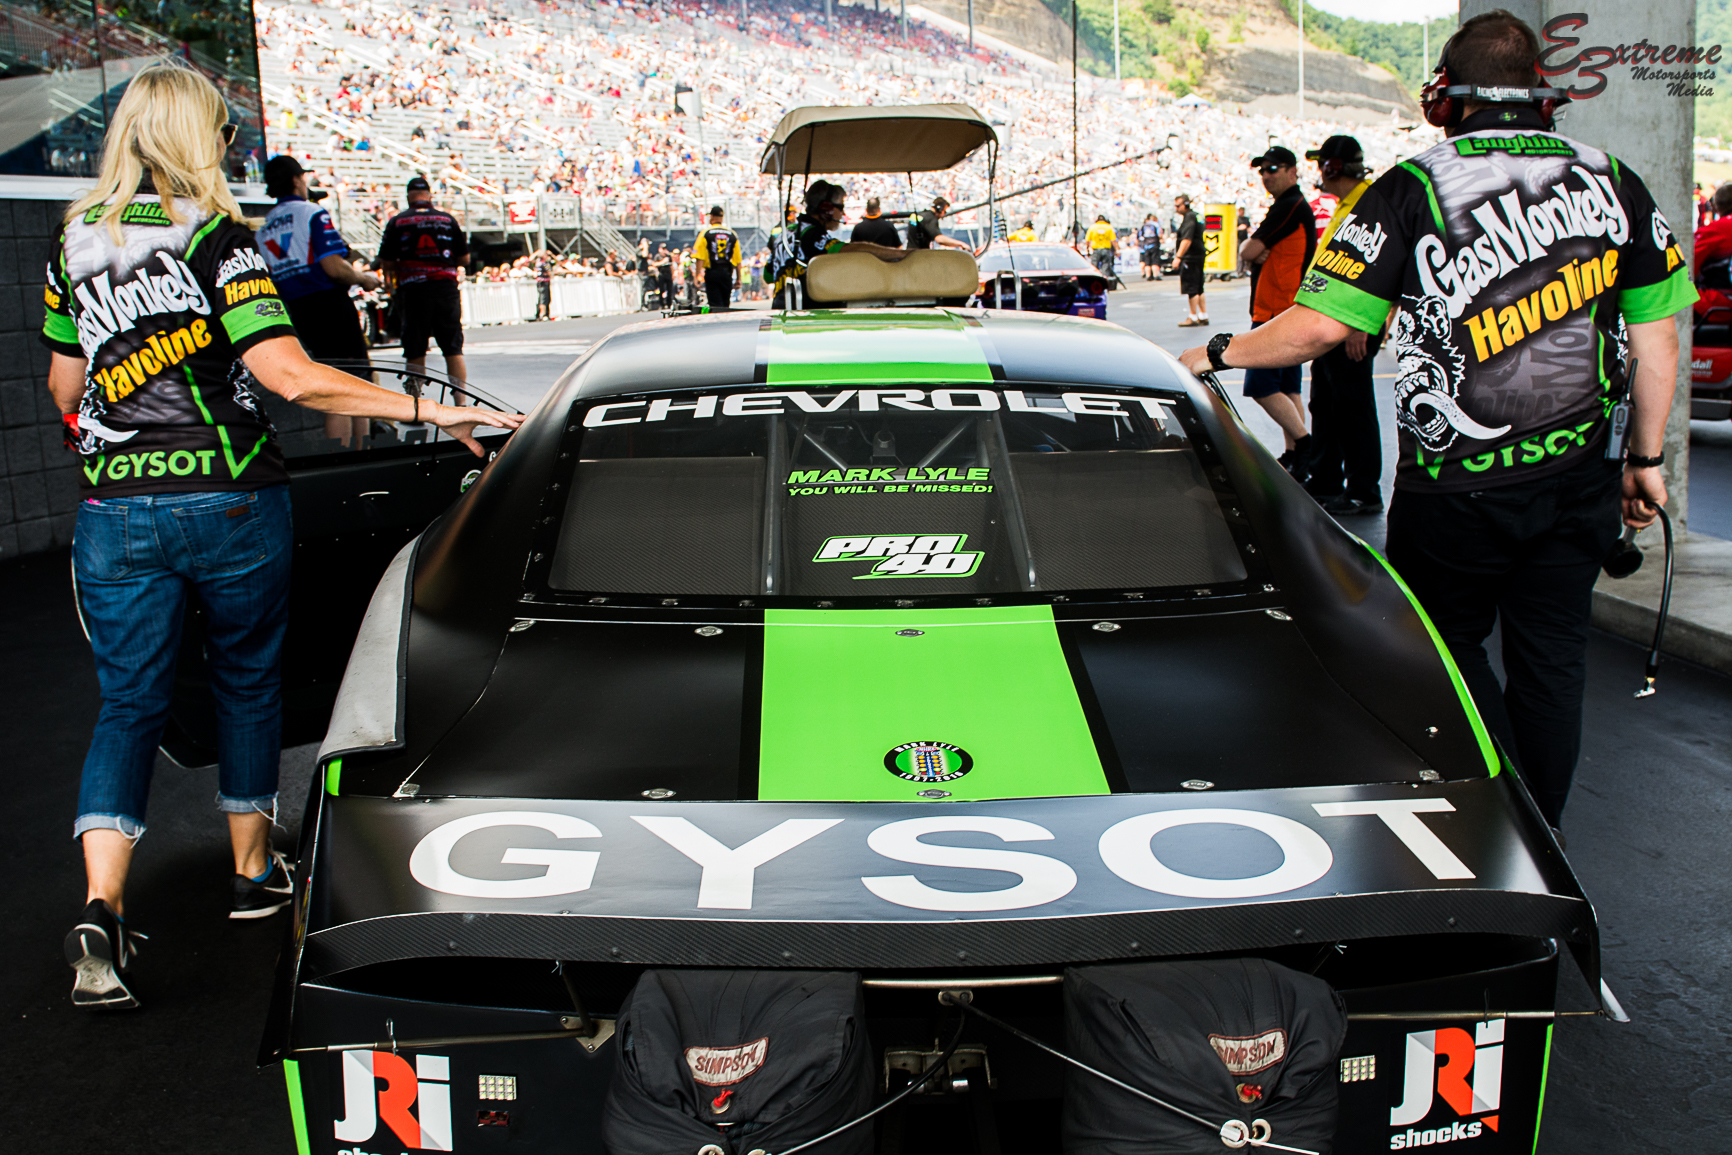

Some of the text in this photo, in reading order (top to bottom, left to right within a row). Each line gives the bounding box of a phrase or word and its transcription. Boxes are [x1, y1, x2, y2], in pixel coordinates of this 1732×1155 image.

[1455, 134, 1570, 156] Laughlin
[1463, 249, 1619, 363] Havoline
[582, 388, 1177, 428] CHEVROLET
[1462, 421, 1595, 472] GYSOT
[107, 450, 216, 480] GYSOT
[787, 467, 990, 484] MARK LYLE
[788, 484, 993, 496] YOU WILL BE MISSED!
[817, 535, 961, 560] PRO
[894, 741, 927, 753] MARK
[410, 798, 1477, 912] GYSOT
[694, 1044, 759, 1075] SIMPSON
[1216, 1033, 1277, 1065] SIMPSON
[1390, 1121, 1483, 1151] shocks
